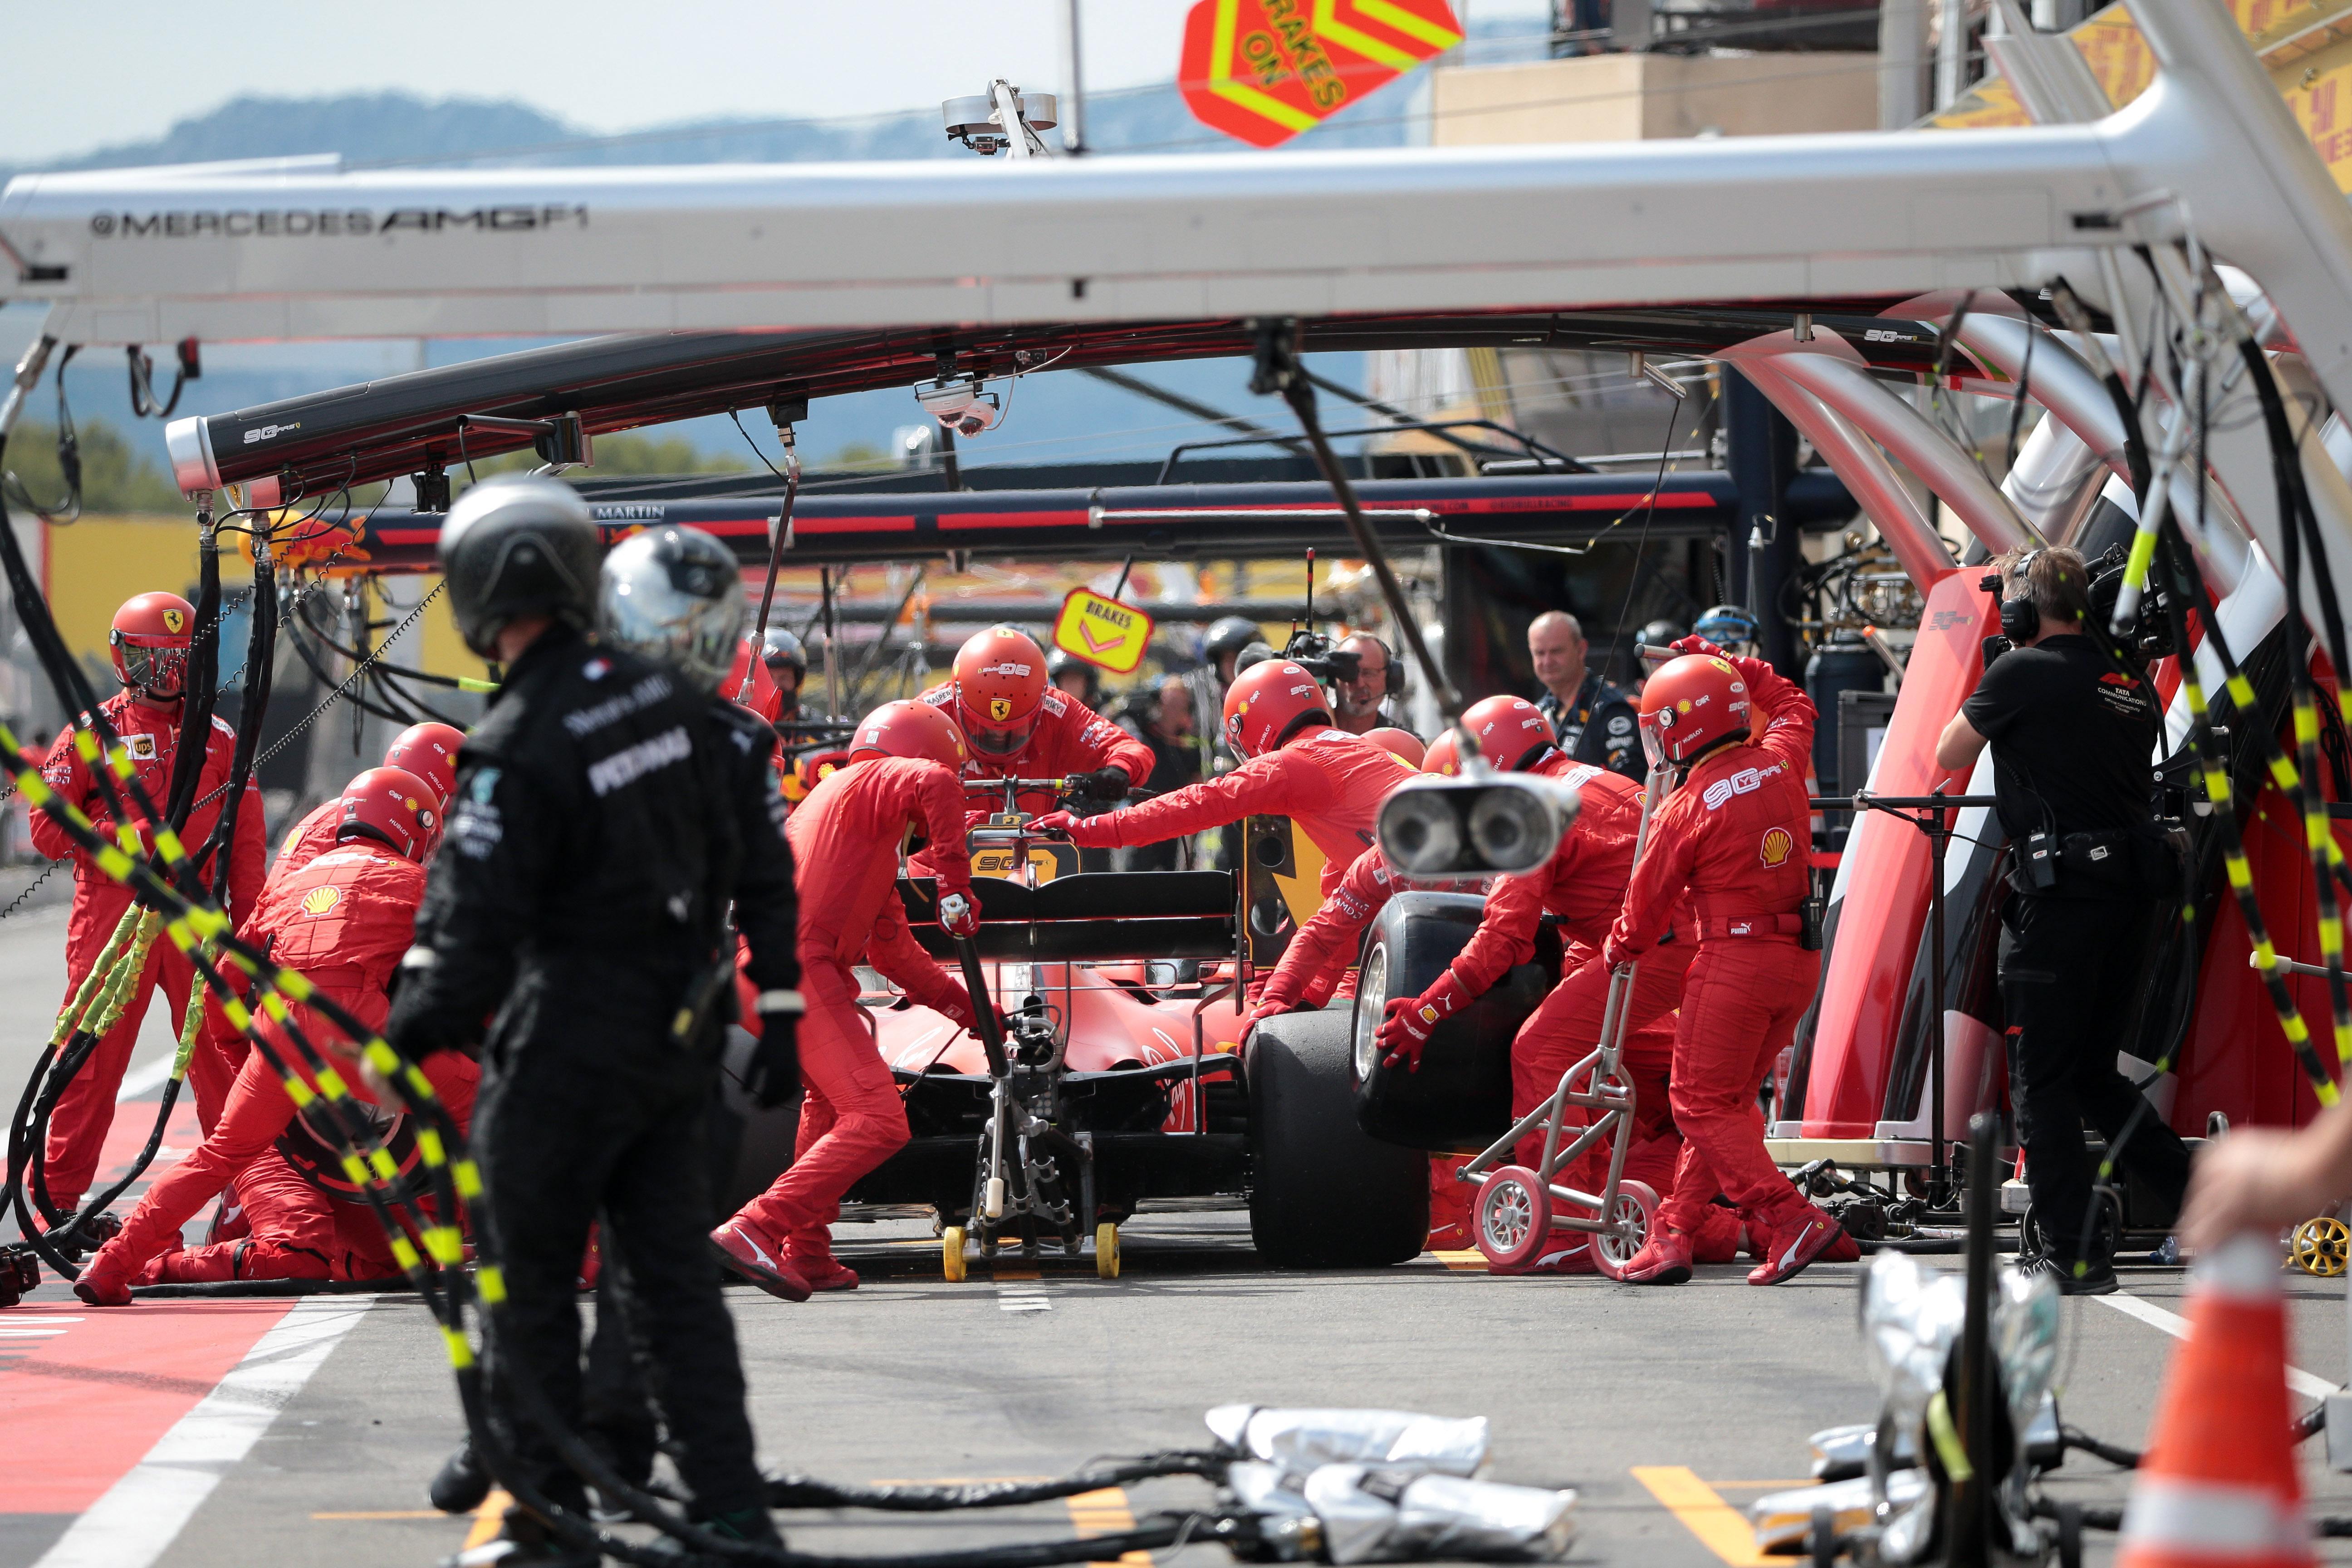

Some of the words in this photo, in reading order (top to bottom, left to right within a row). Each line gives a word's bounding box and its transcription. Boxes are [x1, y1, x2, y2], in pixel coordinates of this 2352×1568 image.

[1243, 34, 1290, 85] ON
[1264, 0, 1344, 108] RAKES
[244, 425, 278, 444] 90
[597, 505, 665, 519] MARTIN
[1086, 599, 1132, 628] BRAKES
[2097, 687, 2147, 706] COMMUNICATIONS
[2115, 687, 2130, 696] TATA
[1259, 724, 1272, 745] HUBLOT
[1682, 728, 1704, 744] HUBLOT
[136, 743, 152, 754] ups
[427, 771, 444, 791] HUBLOT
[1702, 768, 1761, 810] 90
[389, 818, 409, 837] HUBLOT
[1334, 897, 1355, 915] AMD
